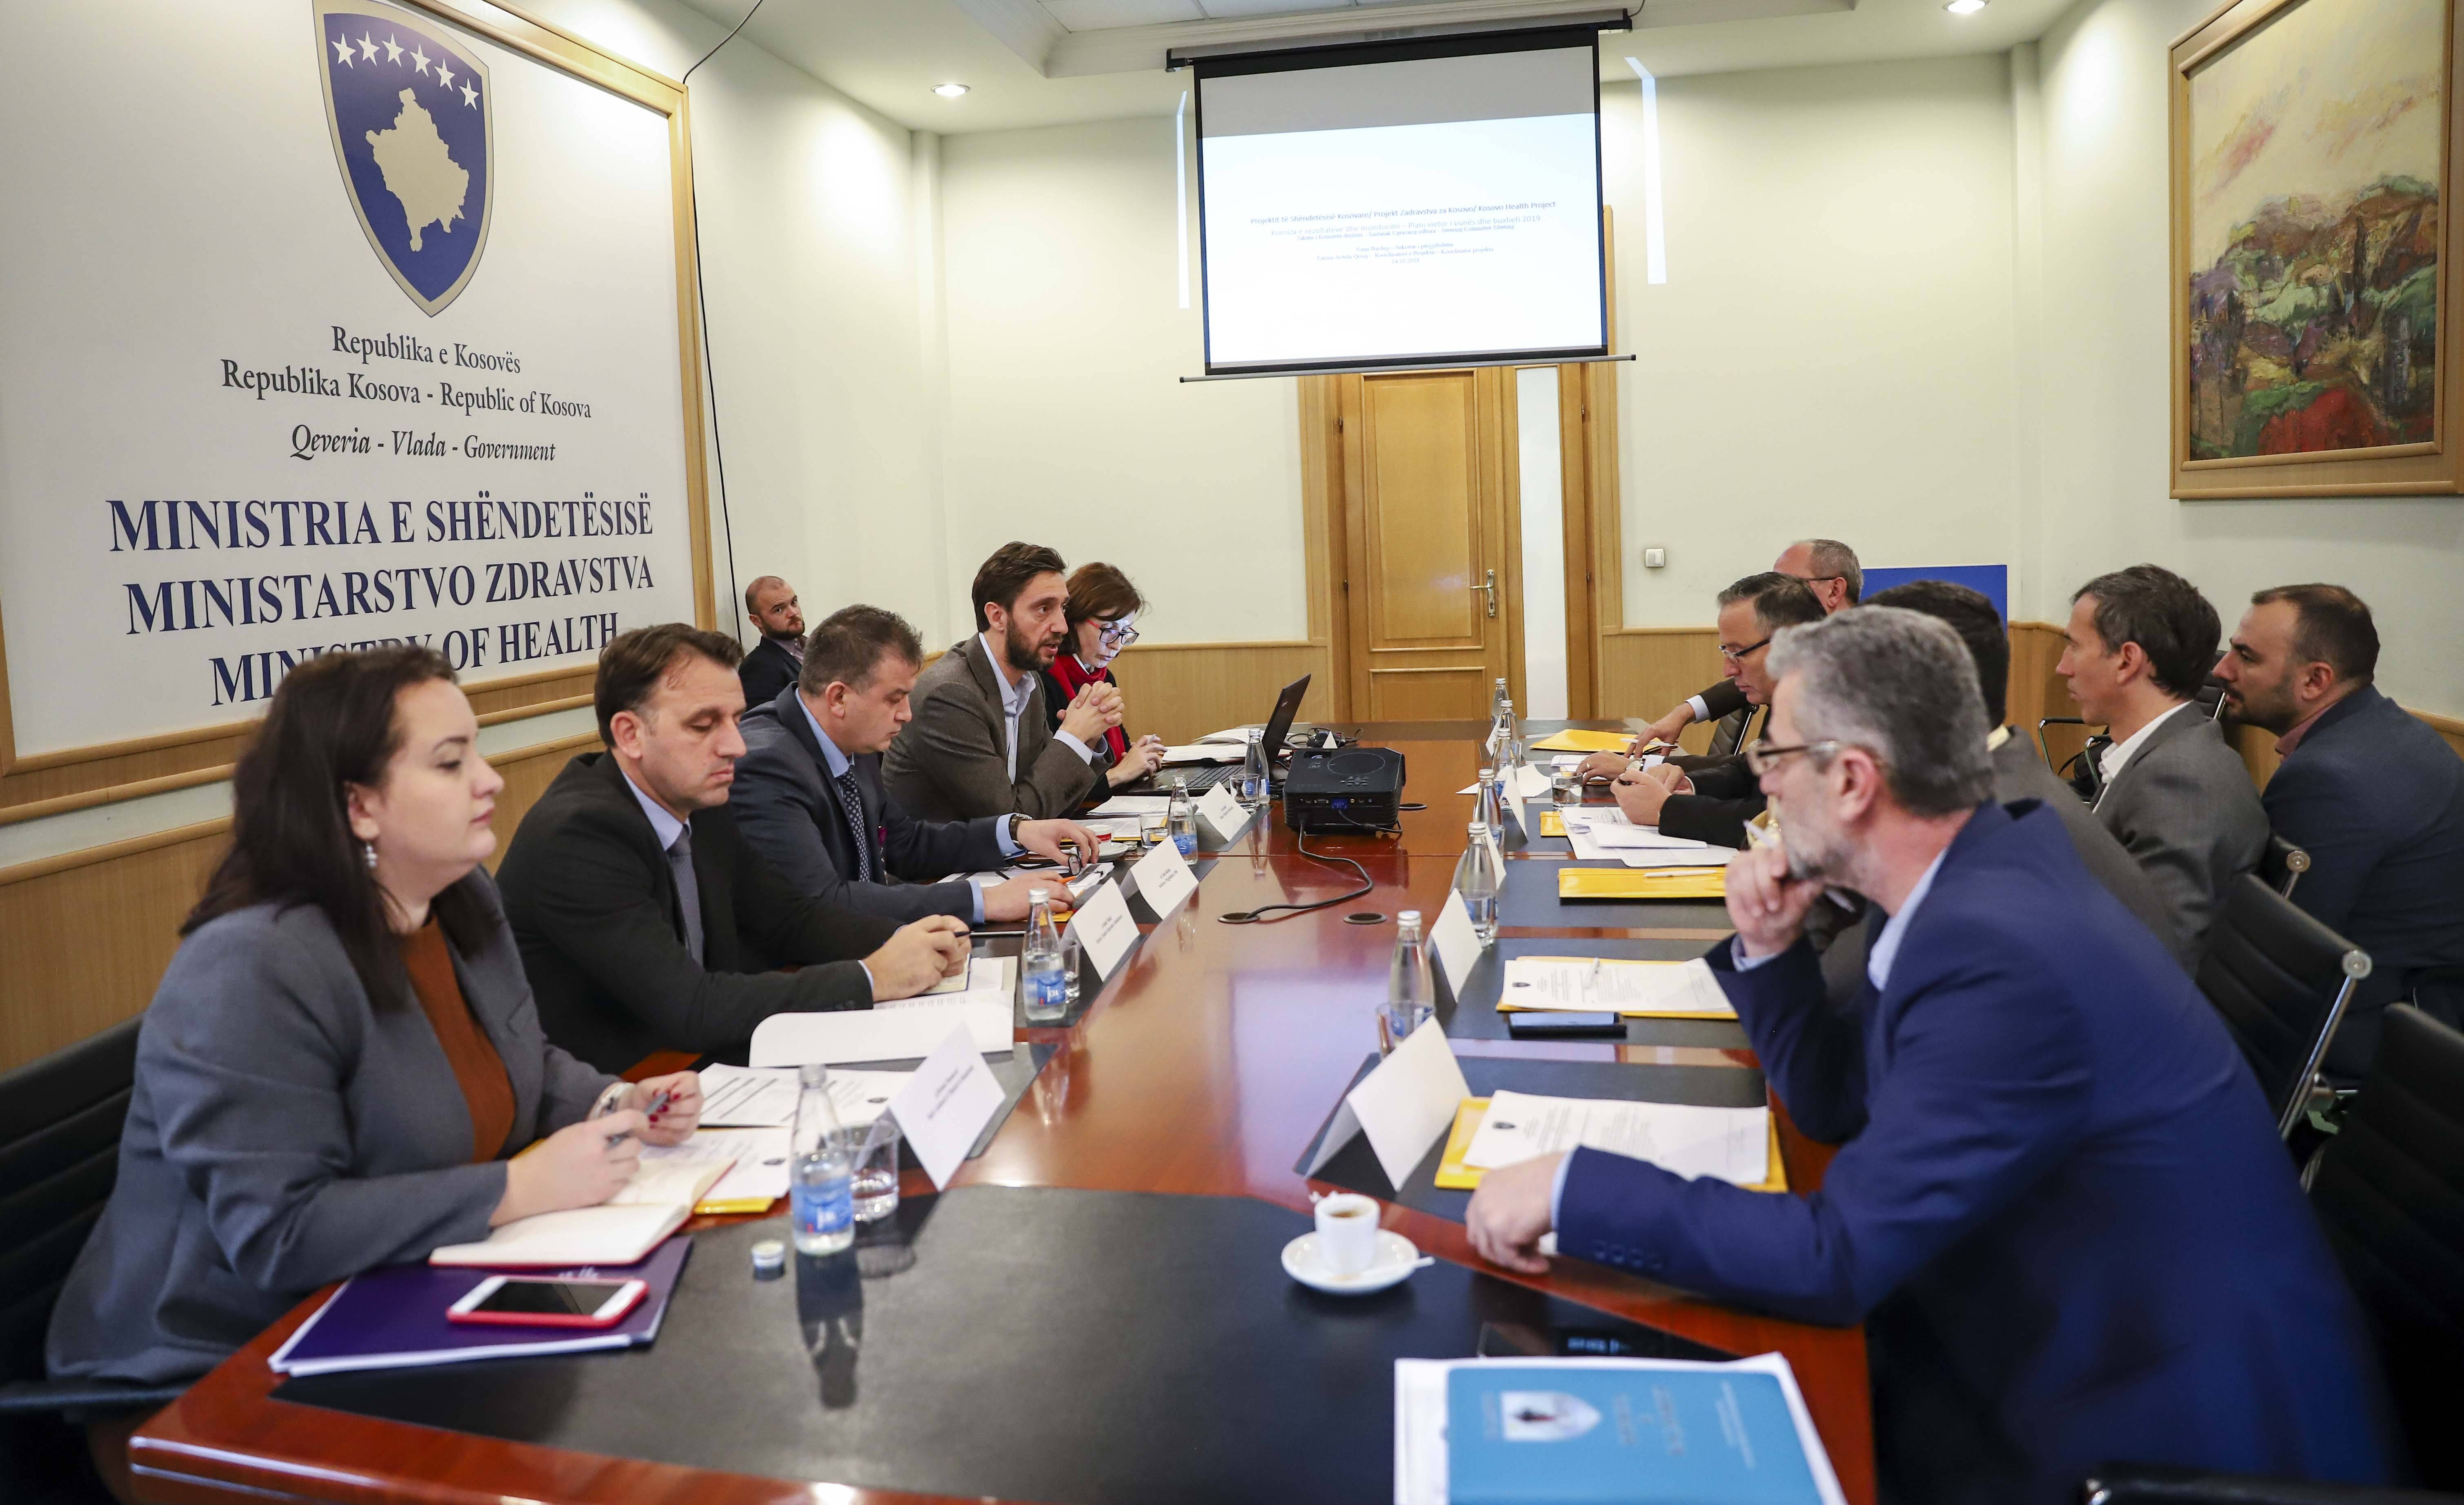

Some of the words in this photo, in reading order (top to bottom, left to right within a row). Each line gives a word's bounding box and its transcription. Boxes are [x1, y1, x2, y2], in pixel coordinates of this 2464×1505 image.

[1250, 216, 1280, 225] Projektit
[1290, 213, 1336, 222] Shëndetësisë
[1338, 211, 1372, 219] Kosovare/
[1374, 210, 1398, 218] Projekt
[1531, 201, 1556, 209] Project
[1361, 223, 1400, 231] monitorimi
[331, 326, 434, 365] Republika
[439, 349, 449, 365] e
[453, 343, 520, 374] Kosovës
[220, 359, 341, 401] Republika
[347, 373, 421, 403] Kosova
[440, 383, 515, 416] Republic
[520, 391, 537, 413] of
[539, 393, 592, 418] Kosova
[289, 425, 371, 461] Qeveria
[391, 430, 447, 457] Vlada
[464, 434, 556, 461] Government
[105, 500, 382, 552] MINISTRIA
[389, 501, 415, 543] E
[427, 490, 653, 543] SHËNDETËSISË
[122, 565, 475, 635] MINISTARSTVO
[485, 555, 655, 603] ZDRAVSTVA
[442, 627, 489, 671] OF
[497, 612, 619, 664] HEALTH
